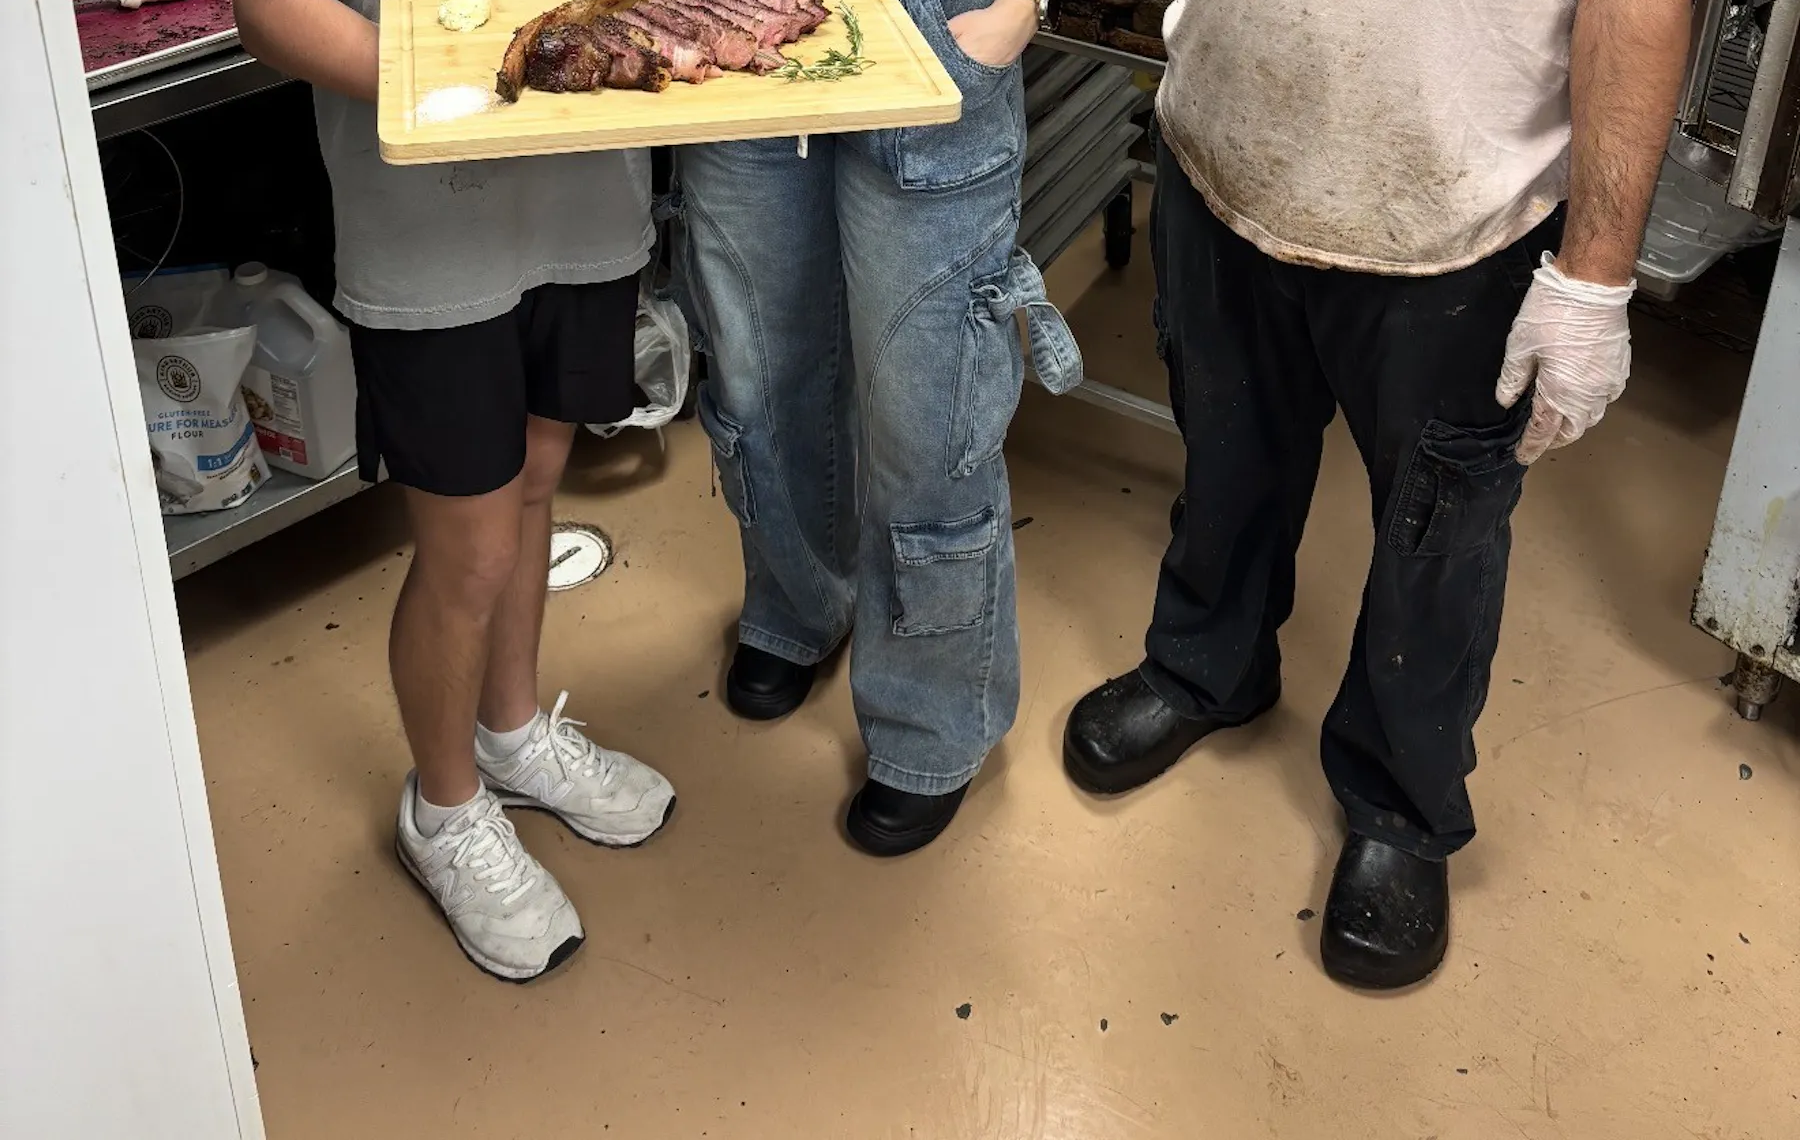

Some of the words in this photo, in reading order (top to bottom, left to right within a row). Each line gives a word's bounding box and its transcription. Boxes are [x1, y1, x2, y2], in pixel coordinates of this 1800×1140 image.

[148, 420, 172, 432] URE
[176, 419, 200, 429] FOR
[171, 430, 204, 440] FLOUR
